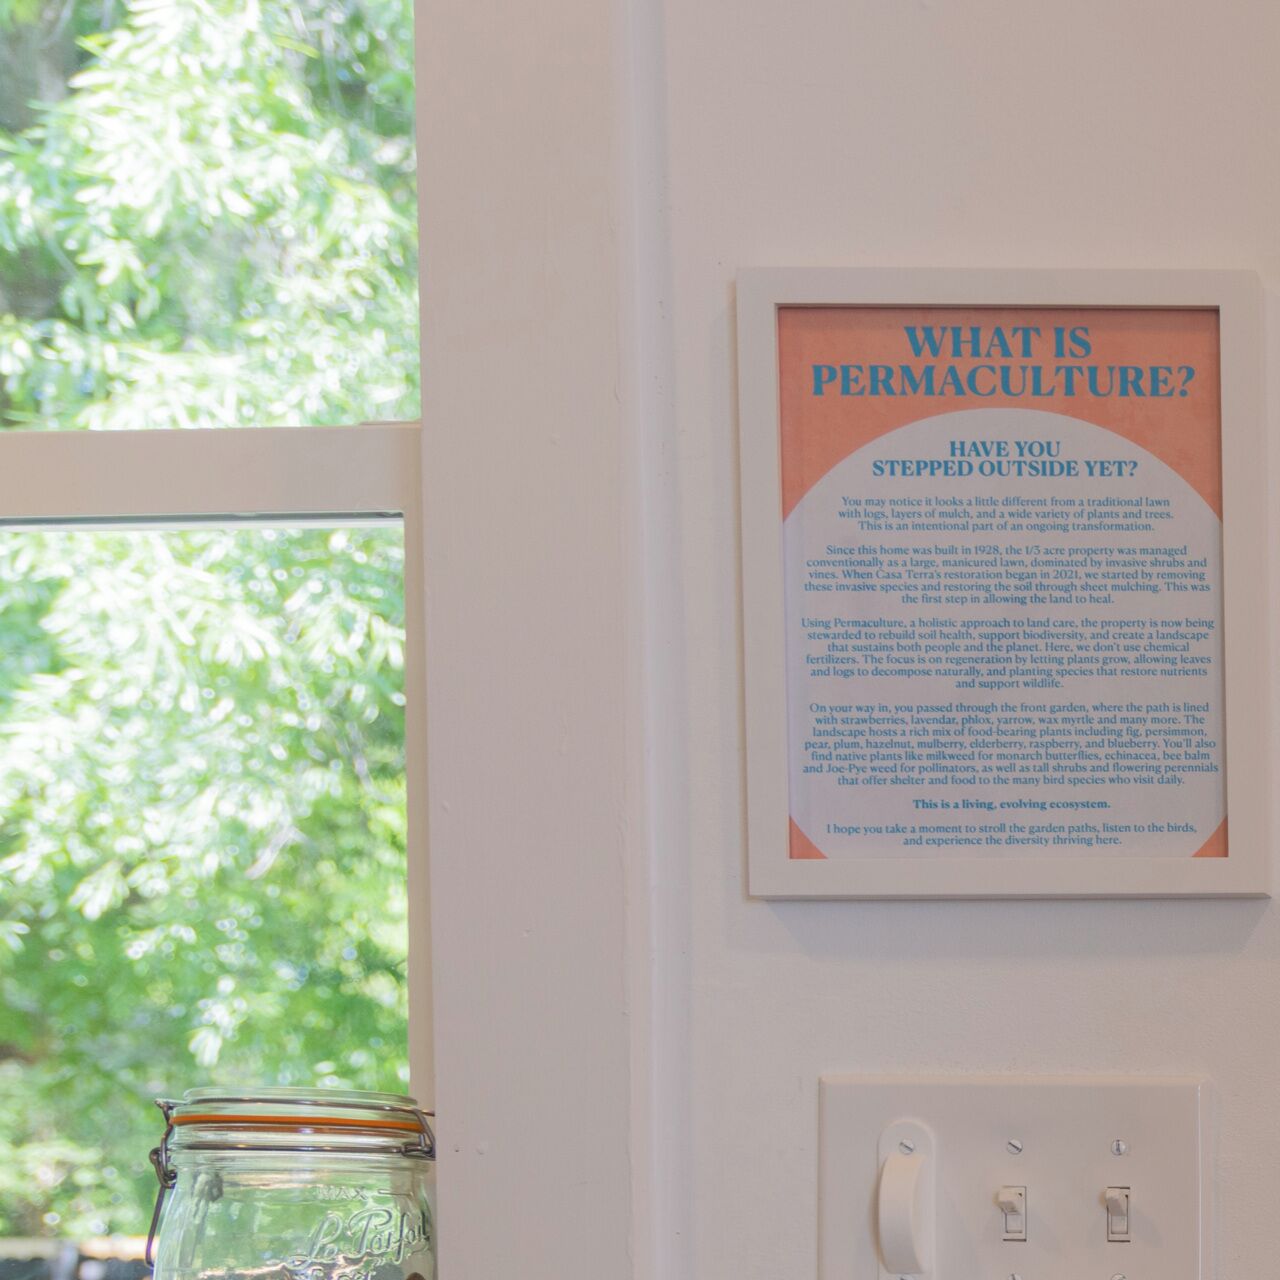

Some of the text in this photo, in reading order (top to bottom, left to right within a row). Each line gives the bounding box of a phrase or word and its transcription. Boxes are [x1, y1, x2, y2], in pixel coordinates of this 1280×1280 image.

[904, 326, 1092, 358] WHAT IS
[811, 364, 1195, 396] PERMACULTURE?
[950, 441, 1060, 457] HAVE YOU
[872, 460, 1138, 477] STEPPED OUTSIDE YET?
[842, 496, 1170, 509] You may notice it looks a little different from a traditional lawn
[860, 520, 1154, 534] This is an intentional part of an ongoing transformation.
[806, 557, 1208, 570] conventionally as a large, manicured lawn, dominated by invasive shrubs and
[803, 581, 834, 591] these
[835, 582, 878, 591] invasive
[879, 582, 919, 594] species
[920, 581, 942, 591] and
[943, 582, 993, 594] restoring
[994, 581, 1012, 591] the
[1013, 581, 1034, 591] soil
[1034, 581, 1078, 594] through
[1079, 581, 1108, 591] sheet
[1110, 581, 1162, 594] mulching.
[1164, 581, 1189, 591] This
[901, 593, 1115, 607] the first step in allowing the land to heal.
[807, 630, 1209, 643] stewarded to rebuild soil health, support biodiversity, and create a landscape
[804, 654, 1212, 667] fertilizers. The focus is on regeneration by letting plants grow, allowing leaves
[810, 666, 1208, 679] and logs to decompose naturally, and planting species that restore nutrients
[955, 678, 1064, 691] and support wildlife.
[812, 726, 866, 740] landscape
[868, 726, 898, 736] hosts
[909, 726, 930, 736] rich
[932, 727, 953, 736] mix
[952, 726, 966, 736] of
[967, 726, 1037, 740] food-bearing
[1039, 726, 1073, 740] plants
[1074, 726, 1124, 740] including
[1125, 726, 1142, 740] fig,
[1144, 727, 1208, 740] persimmon,
[804, 738, 1216, 752] pear, plum, hazelnut, mulberry, elderberry, raspberry, and blueberry. You'll also
[912, 799, 1112, 812] This is a living, evolving ecosystem.
[902, 835, 1122, 848] and experience the diversity thriving here.
[318, 1187, 368, 1200] MAX
